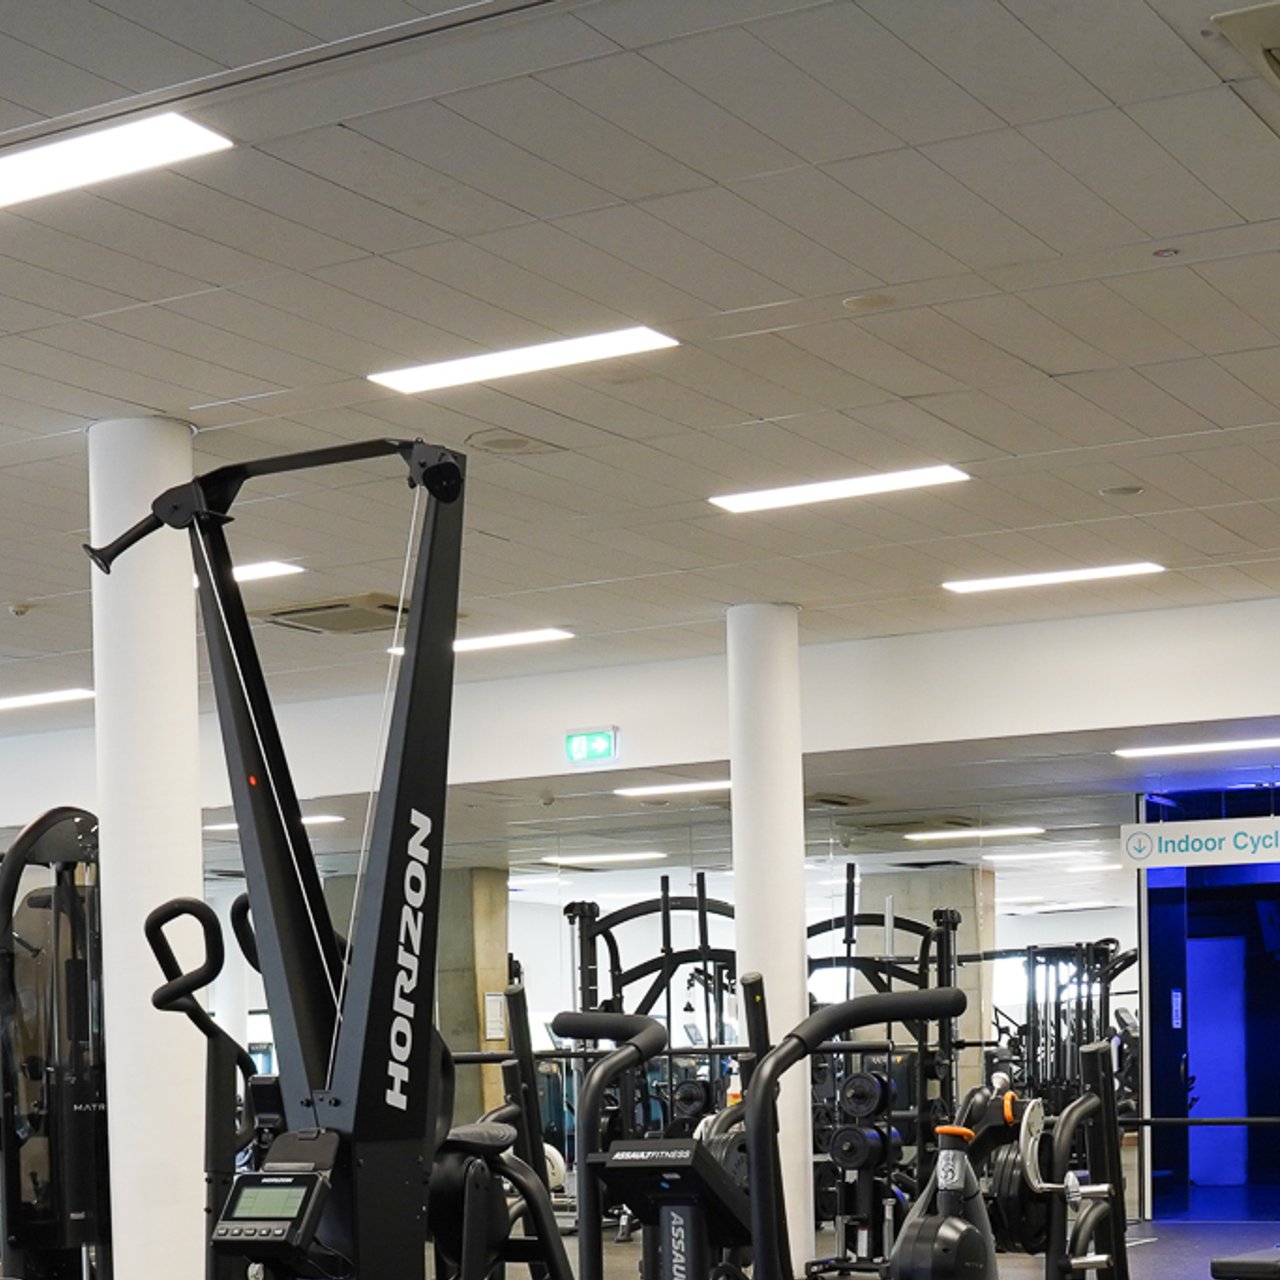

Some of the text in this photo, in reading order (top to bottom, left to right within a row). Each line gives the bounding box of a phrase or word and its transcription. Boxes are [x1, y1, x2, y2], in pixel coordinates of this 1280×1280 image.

[1157, 834, 1225, 853] Indoor
[386, 808, 432, 1111] HORIZON
[73, 1103, 106, 1111] MATR
